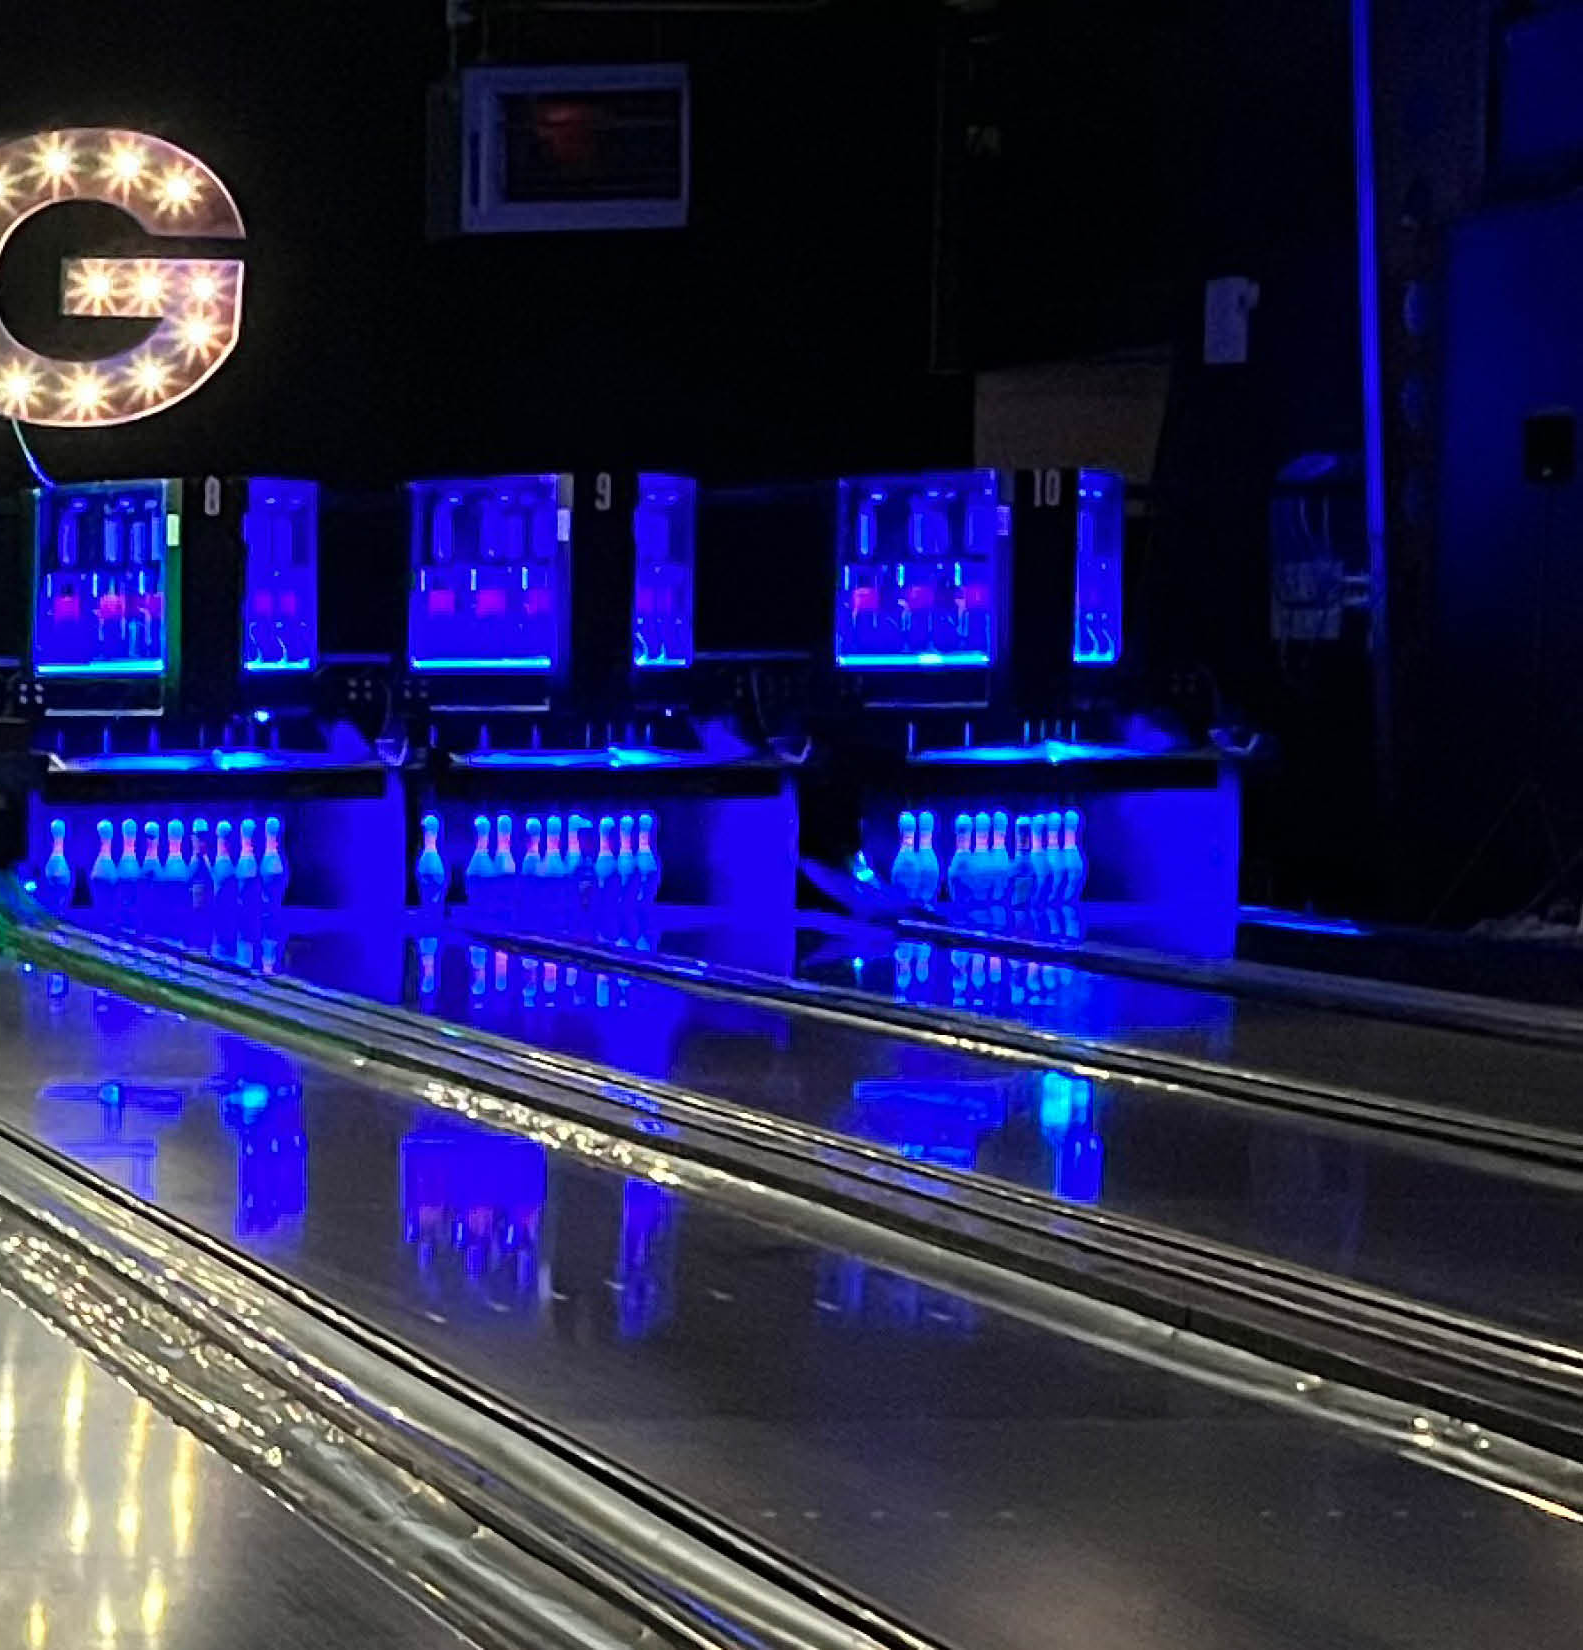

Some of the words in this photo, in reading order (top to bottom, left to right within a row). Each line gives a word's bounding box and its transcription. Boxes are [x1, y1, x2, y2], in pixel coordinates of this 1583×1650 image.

[204, 474, 221, 516] 8
[594, 471, 612, 511] 9
[1032, 468, 1062, 508] 10
